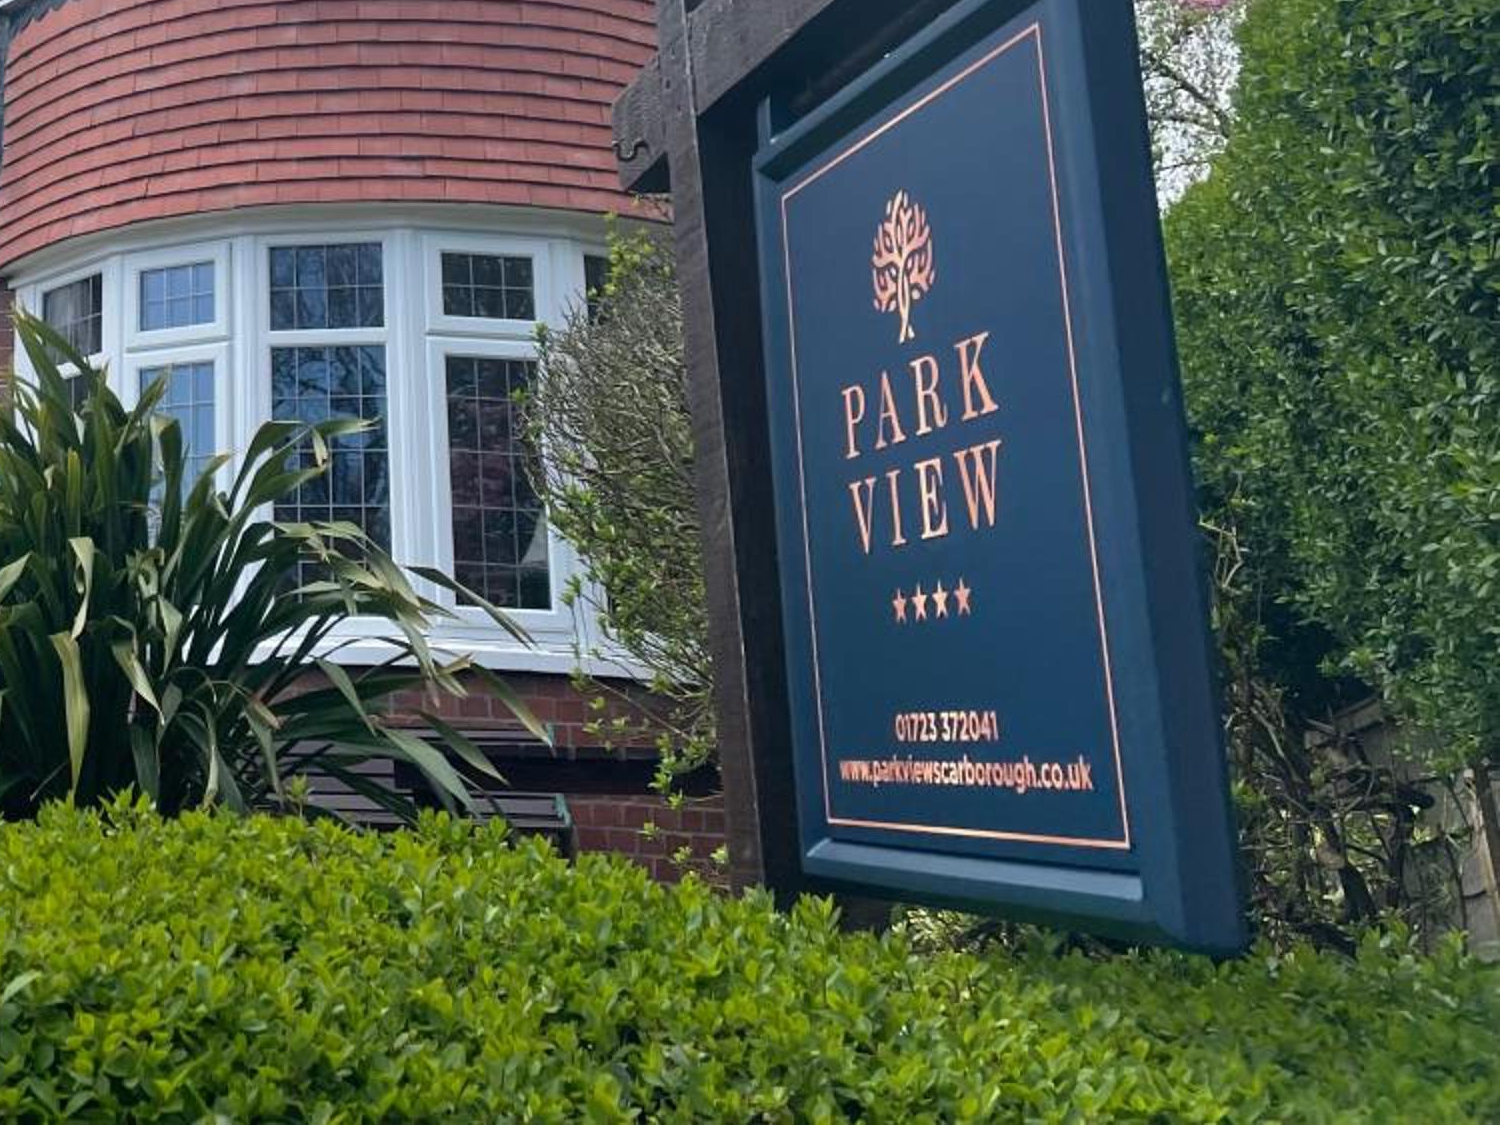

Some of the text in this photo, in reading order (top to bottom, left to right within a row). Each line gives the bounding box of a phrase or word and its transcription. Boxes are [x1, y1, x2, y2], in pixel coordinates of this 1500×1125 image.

[841, 331, 999, 459] PARK
[849, 439, 1002, 555] VIEW
[895, 710, 999, 742] 01723 372041
[839, 754, 1093, 793] www.parkviewscarborough.co.uk
